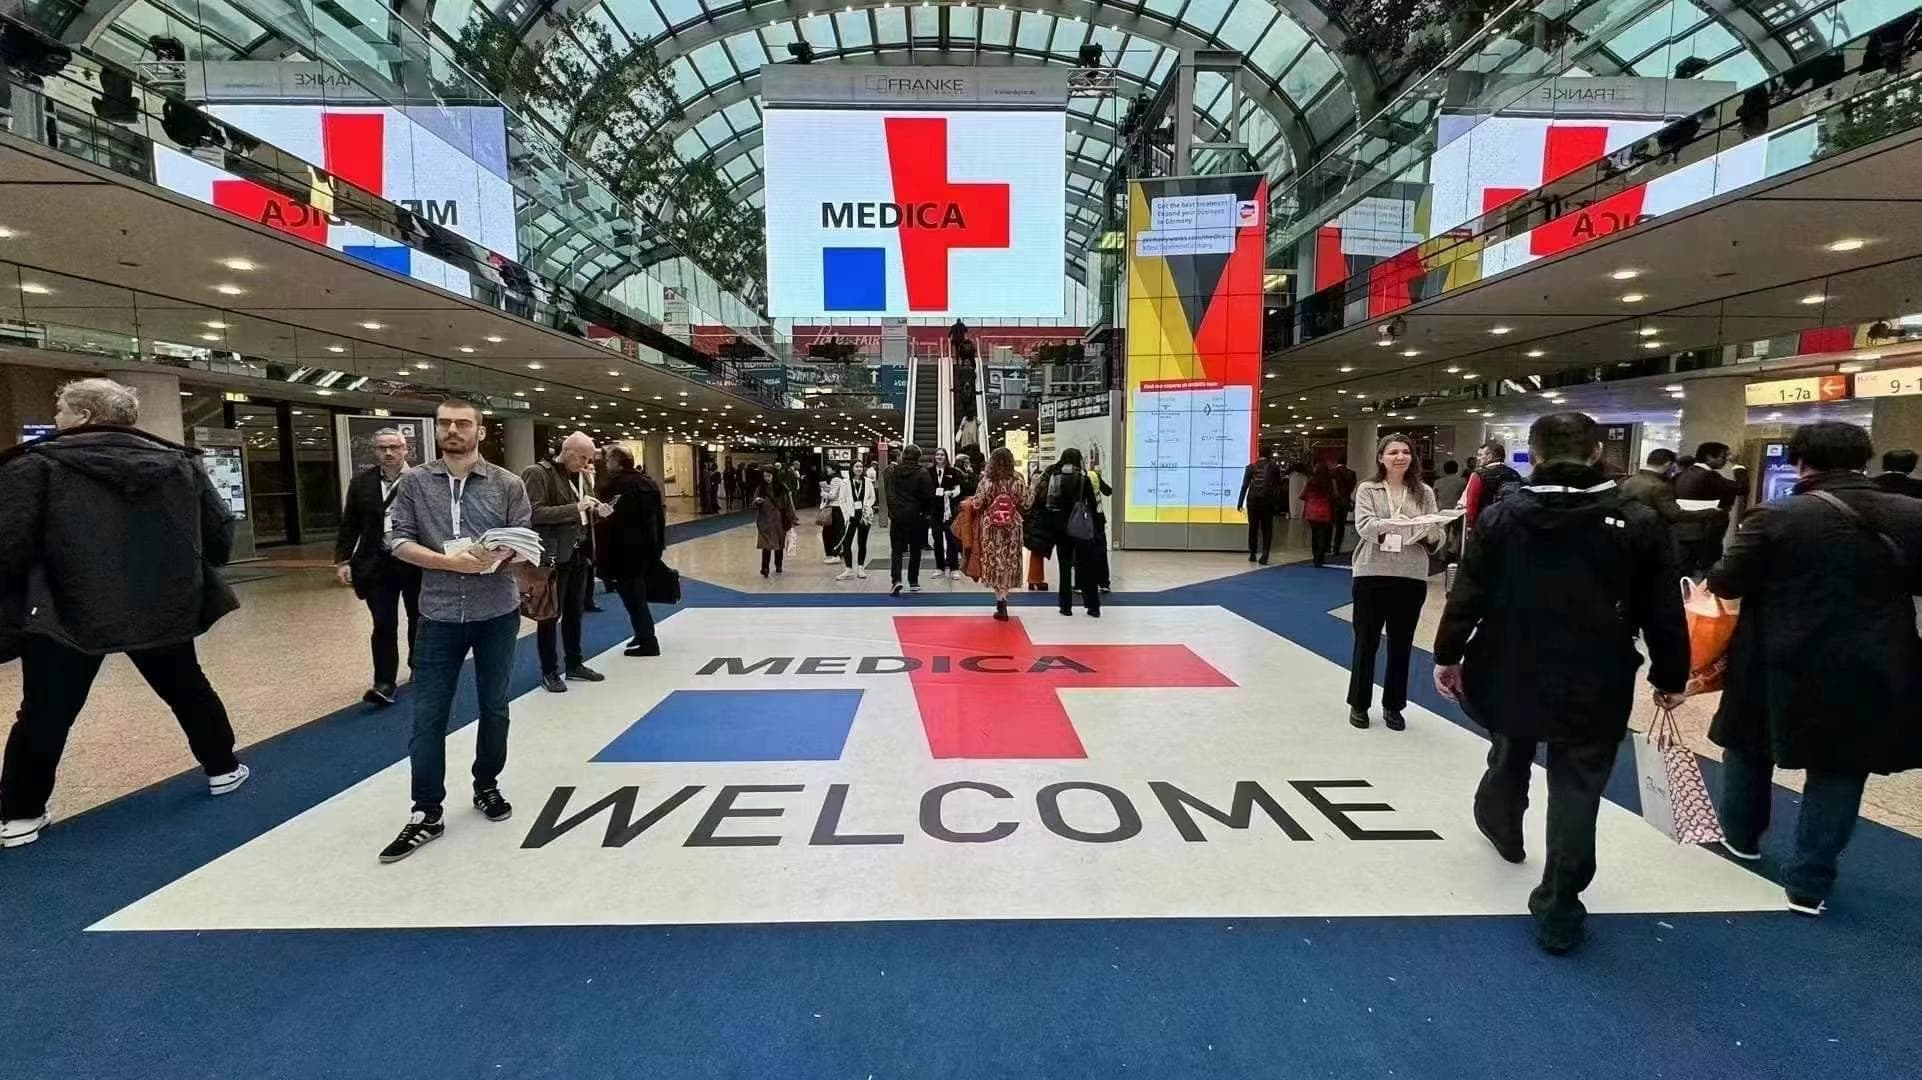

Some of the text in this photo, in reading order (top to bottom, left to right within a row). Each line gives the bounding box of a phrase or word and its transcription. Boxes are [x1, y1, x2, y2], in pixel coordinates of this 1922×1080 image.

[888, 79, 964, 91] FRANKE
[822, 202, 967, 229] MEDICA
[1779, 387, 1811, 400] 1-7a
[695, 655, 1097, 675] MEDICA
[519, 780, 1445, 849] WELCOME
